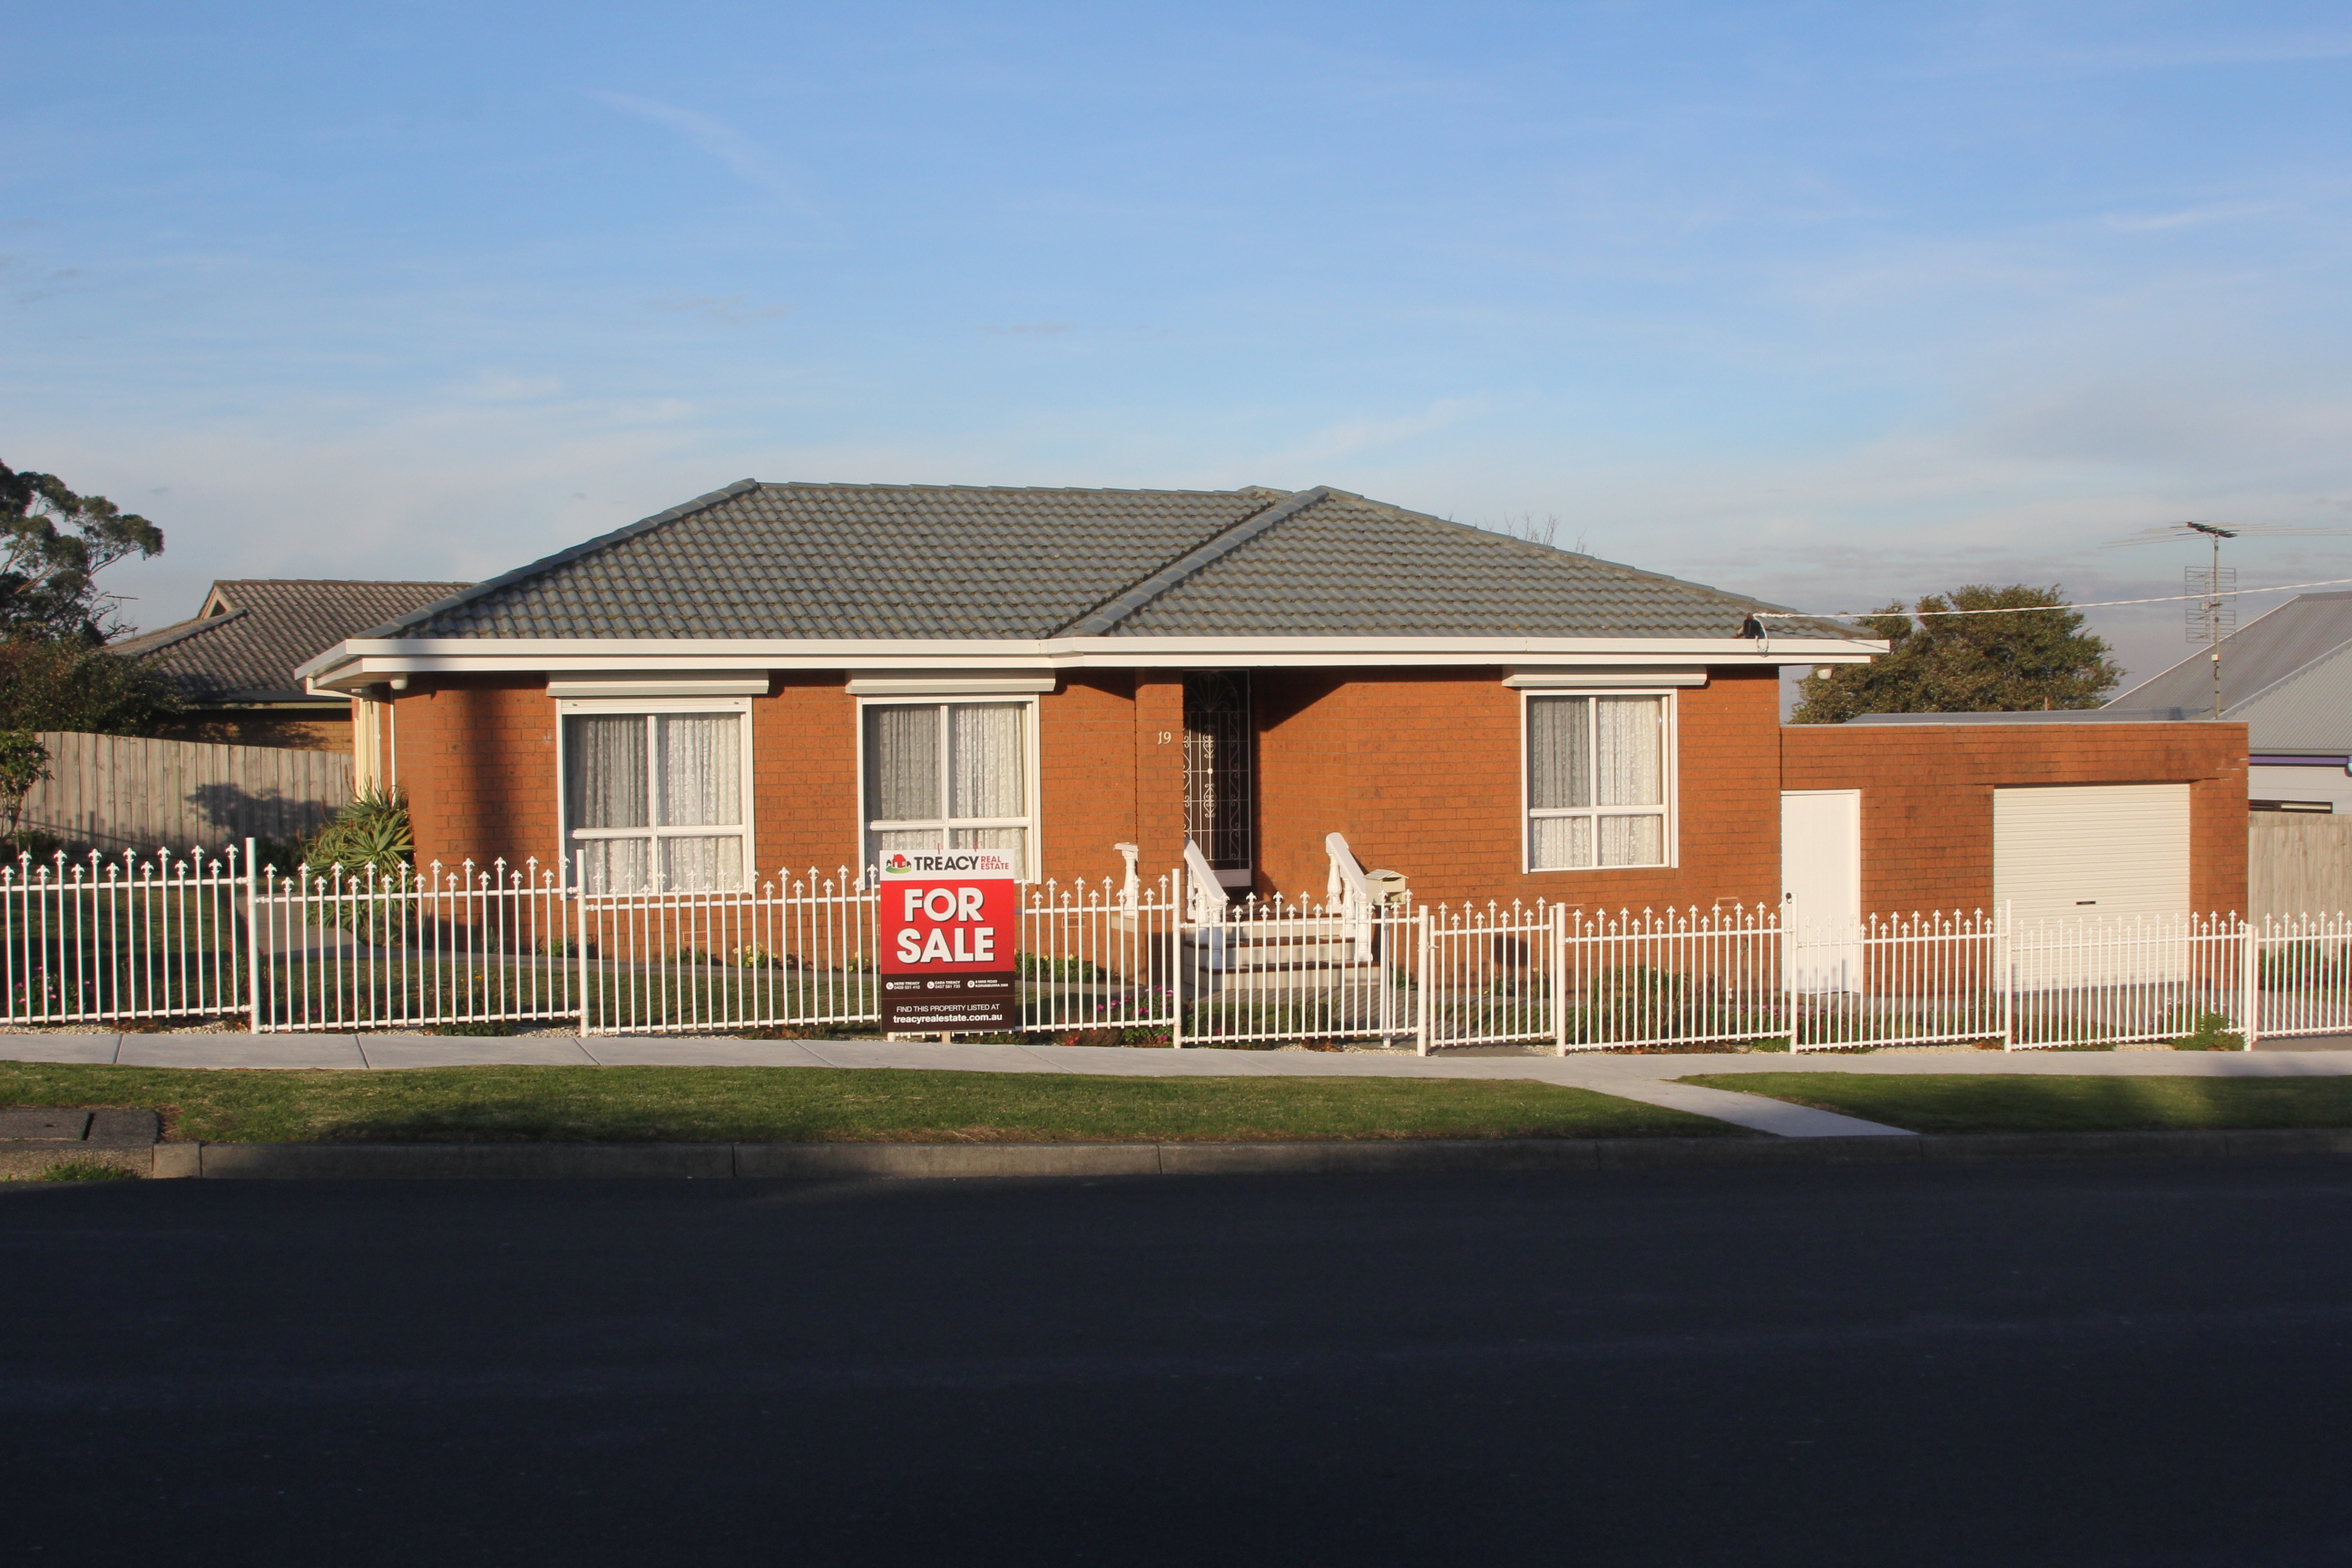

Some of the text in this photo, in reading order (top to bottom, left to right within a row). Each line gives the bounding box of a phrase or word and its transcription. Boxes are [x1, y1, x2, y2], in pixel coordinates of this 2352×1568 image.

[1158, 730, 1171, 745] 19
[914, 856, 979, 871] TREACY
[981, 862, 1009, 870] ESTATE
[905, 887, 985, 922] FOR
[897, 926, 995, 964] SALE
[893, 1014, 1003, 1024] treacyrealestate.com.au
